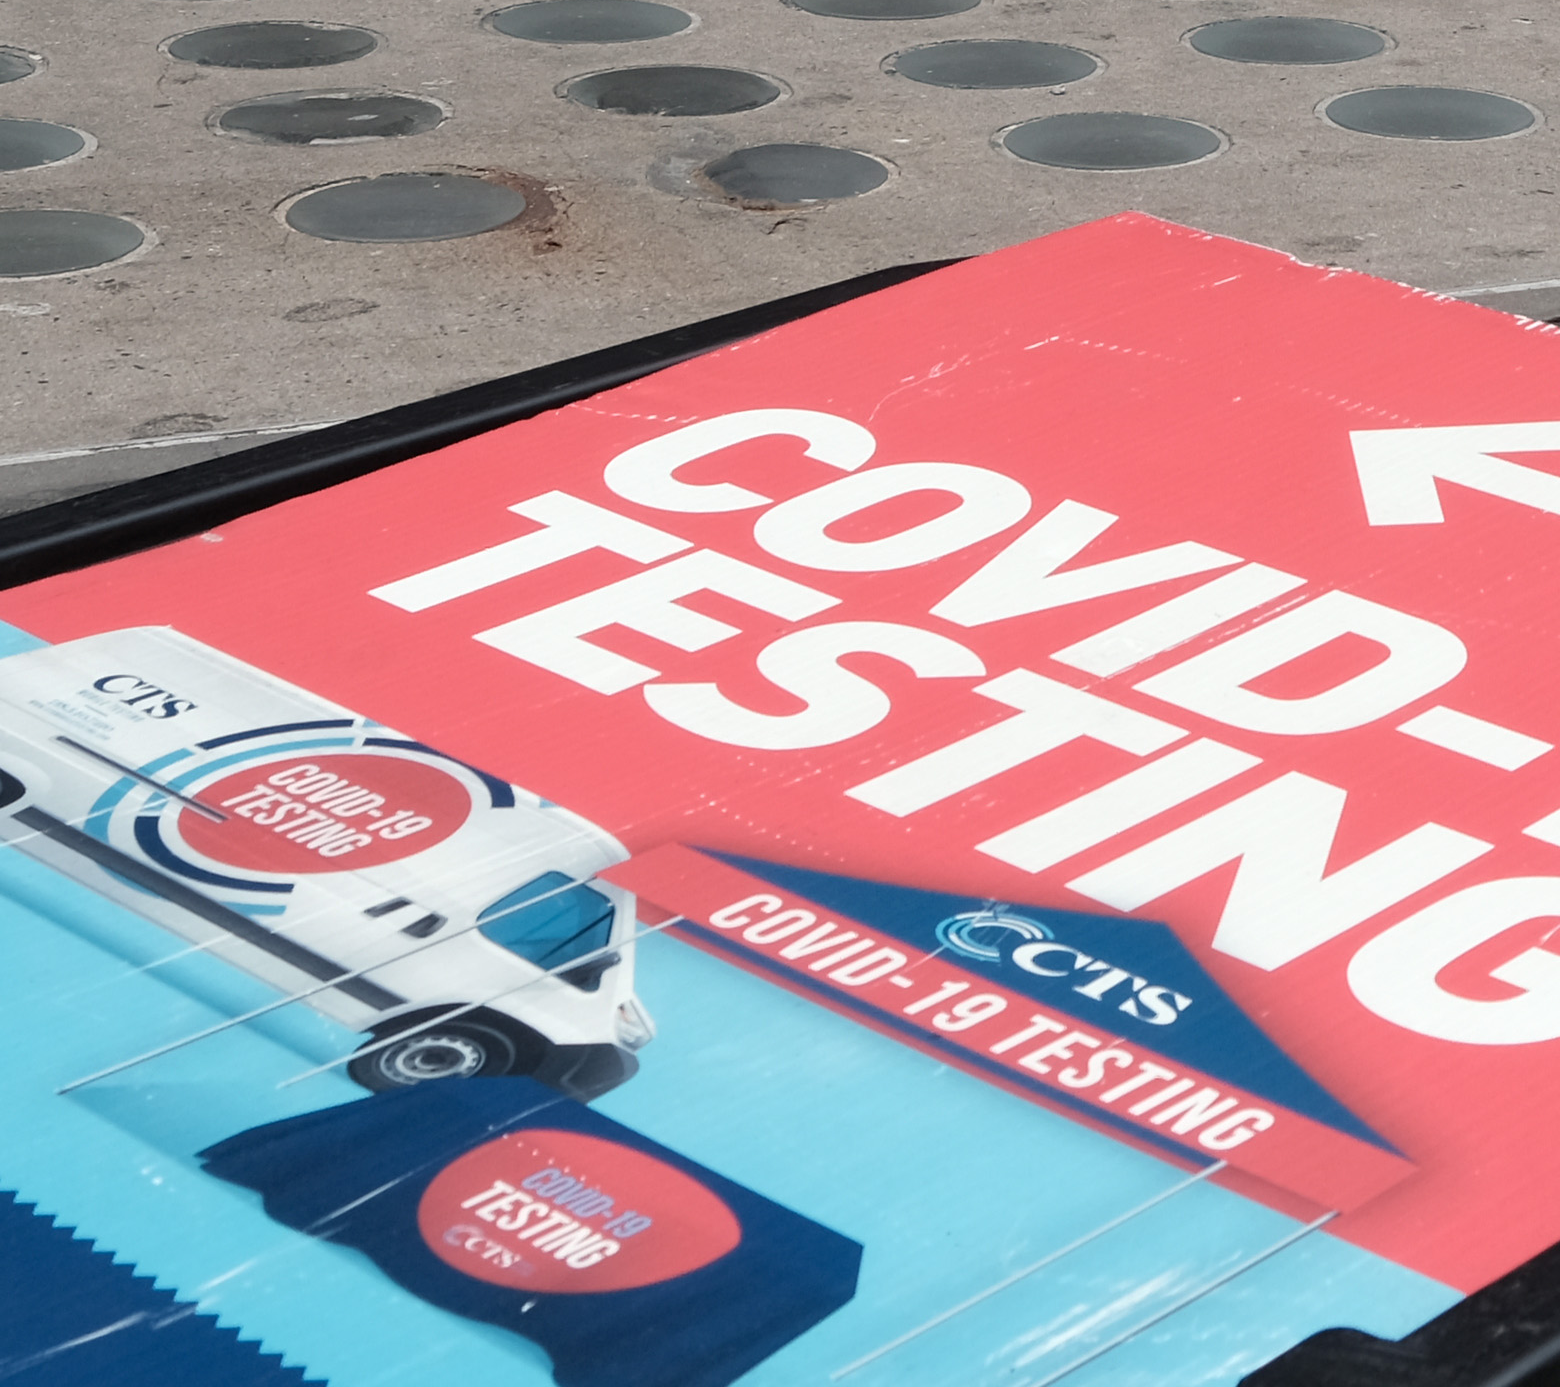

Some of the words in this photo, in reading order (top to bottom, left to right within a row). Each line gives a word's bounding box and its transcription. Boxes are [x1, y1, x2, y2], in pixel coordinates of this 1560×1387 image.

[93, 674, 197, 720] CTS
[220, 784, 372, 859] TESTING
[268, 764, 433, 841] COVID-19
[1011, 940, 1193, 1026] CTS
[709, 893, 1007, 1033] COVID-19
[989, 1014, 1275, 1152] TESTING
[460, 1180, 621, 1269] TESTING
[521, 1167, 653, 1239] COVID-19
